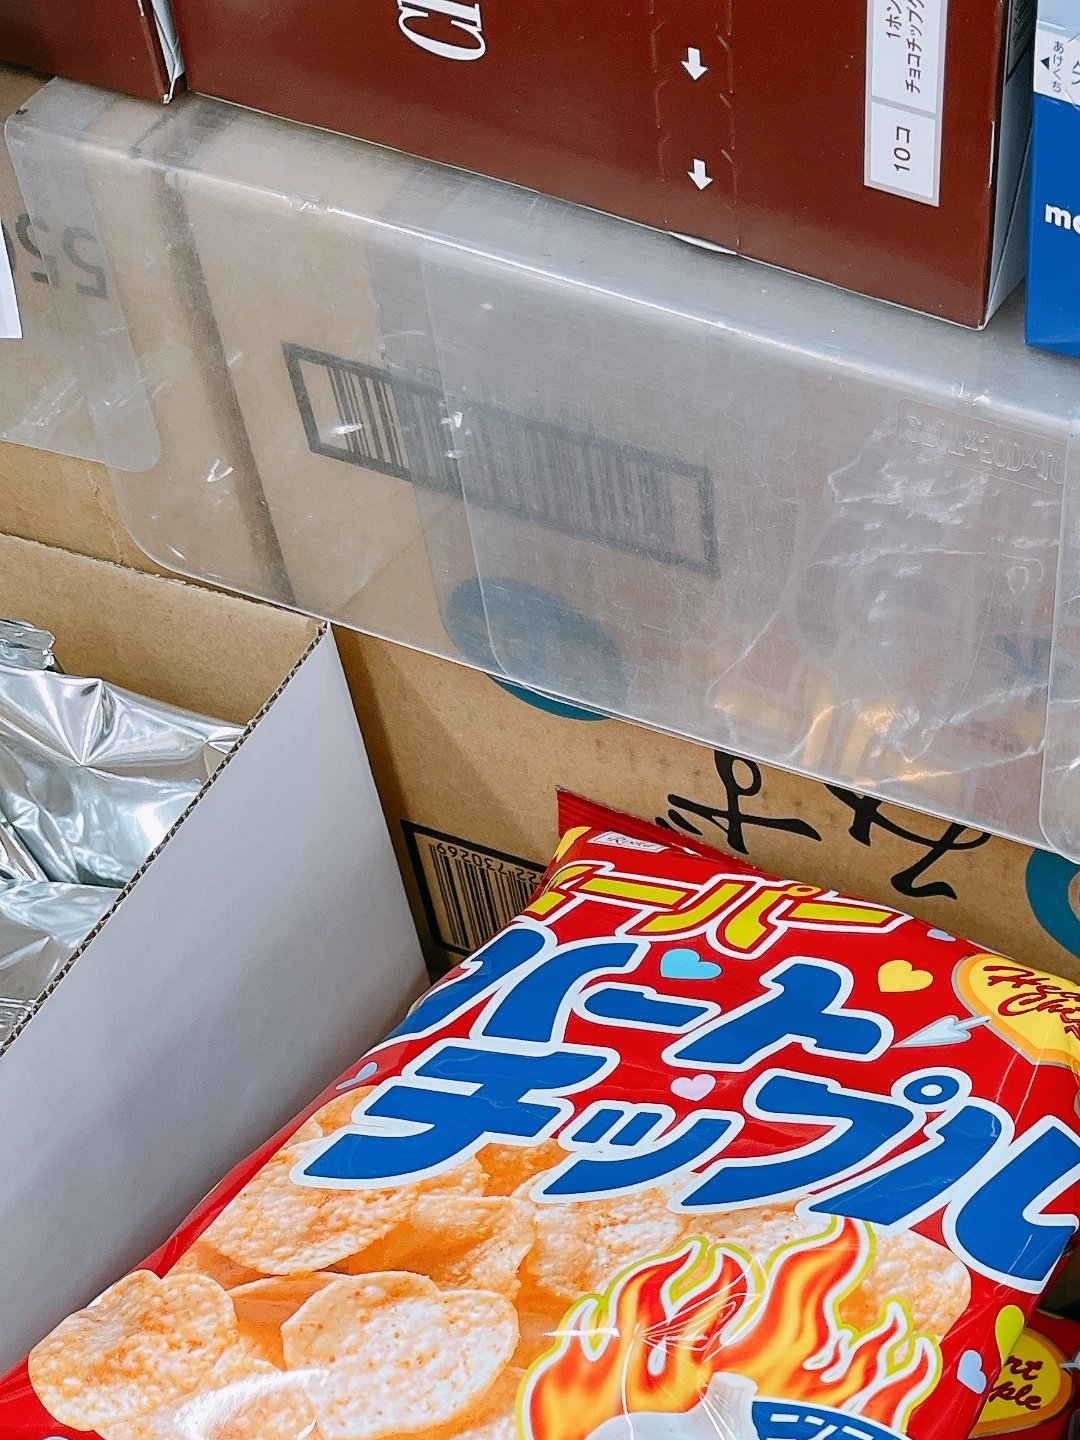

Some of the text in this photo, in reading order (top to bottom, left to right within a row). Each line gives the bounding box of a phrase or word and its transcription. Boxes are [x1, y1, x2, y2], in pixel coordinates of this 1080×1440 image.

[1051, 41, 1065, 94] あけくち
[384, 925, 896, 1073] ハート
